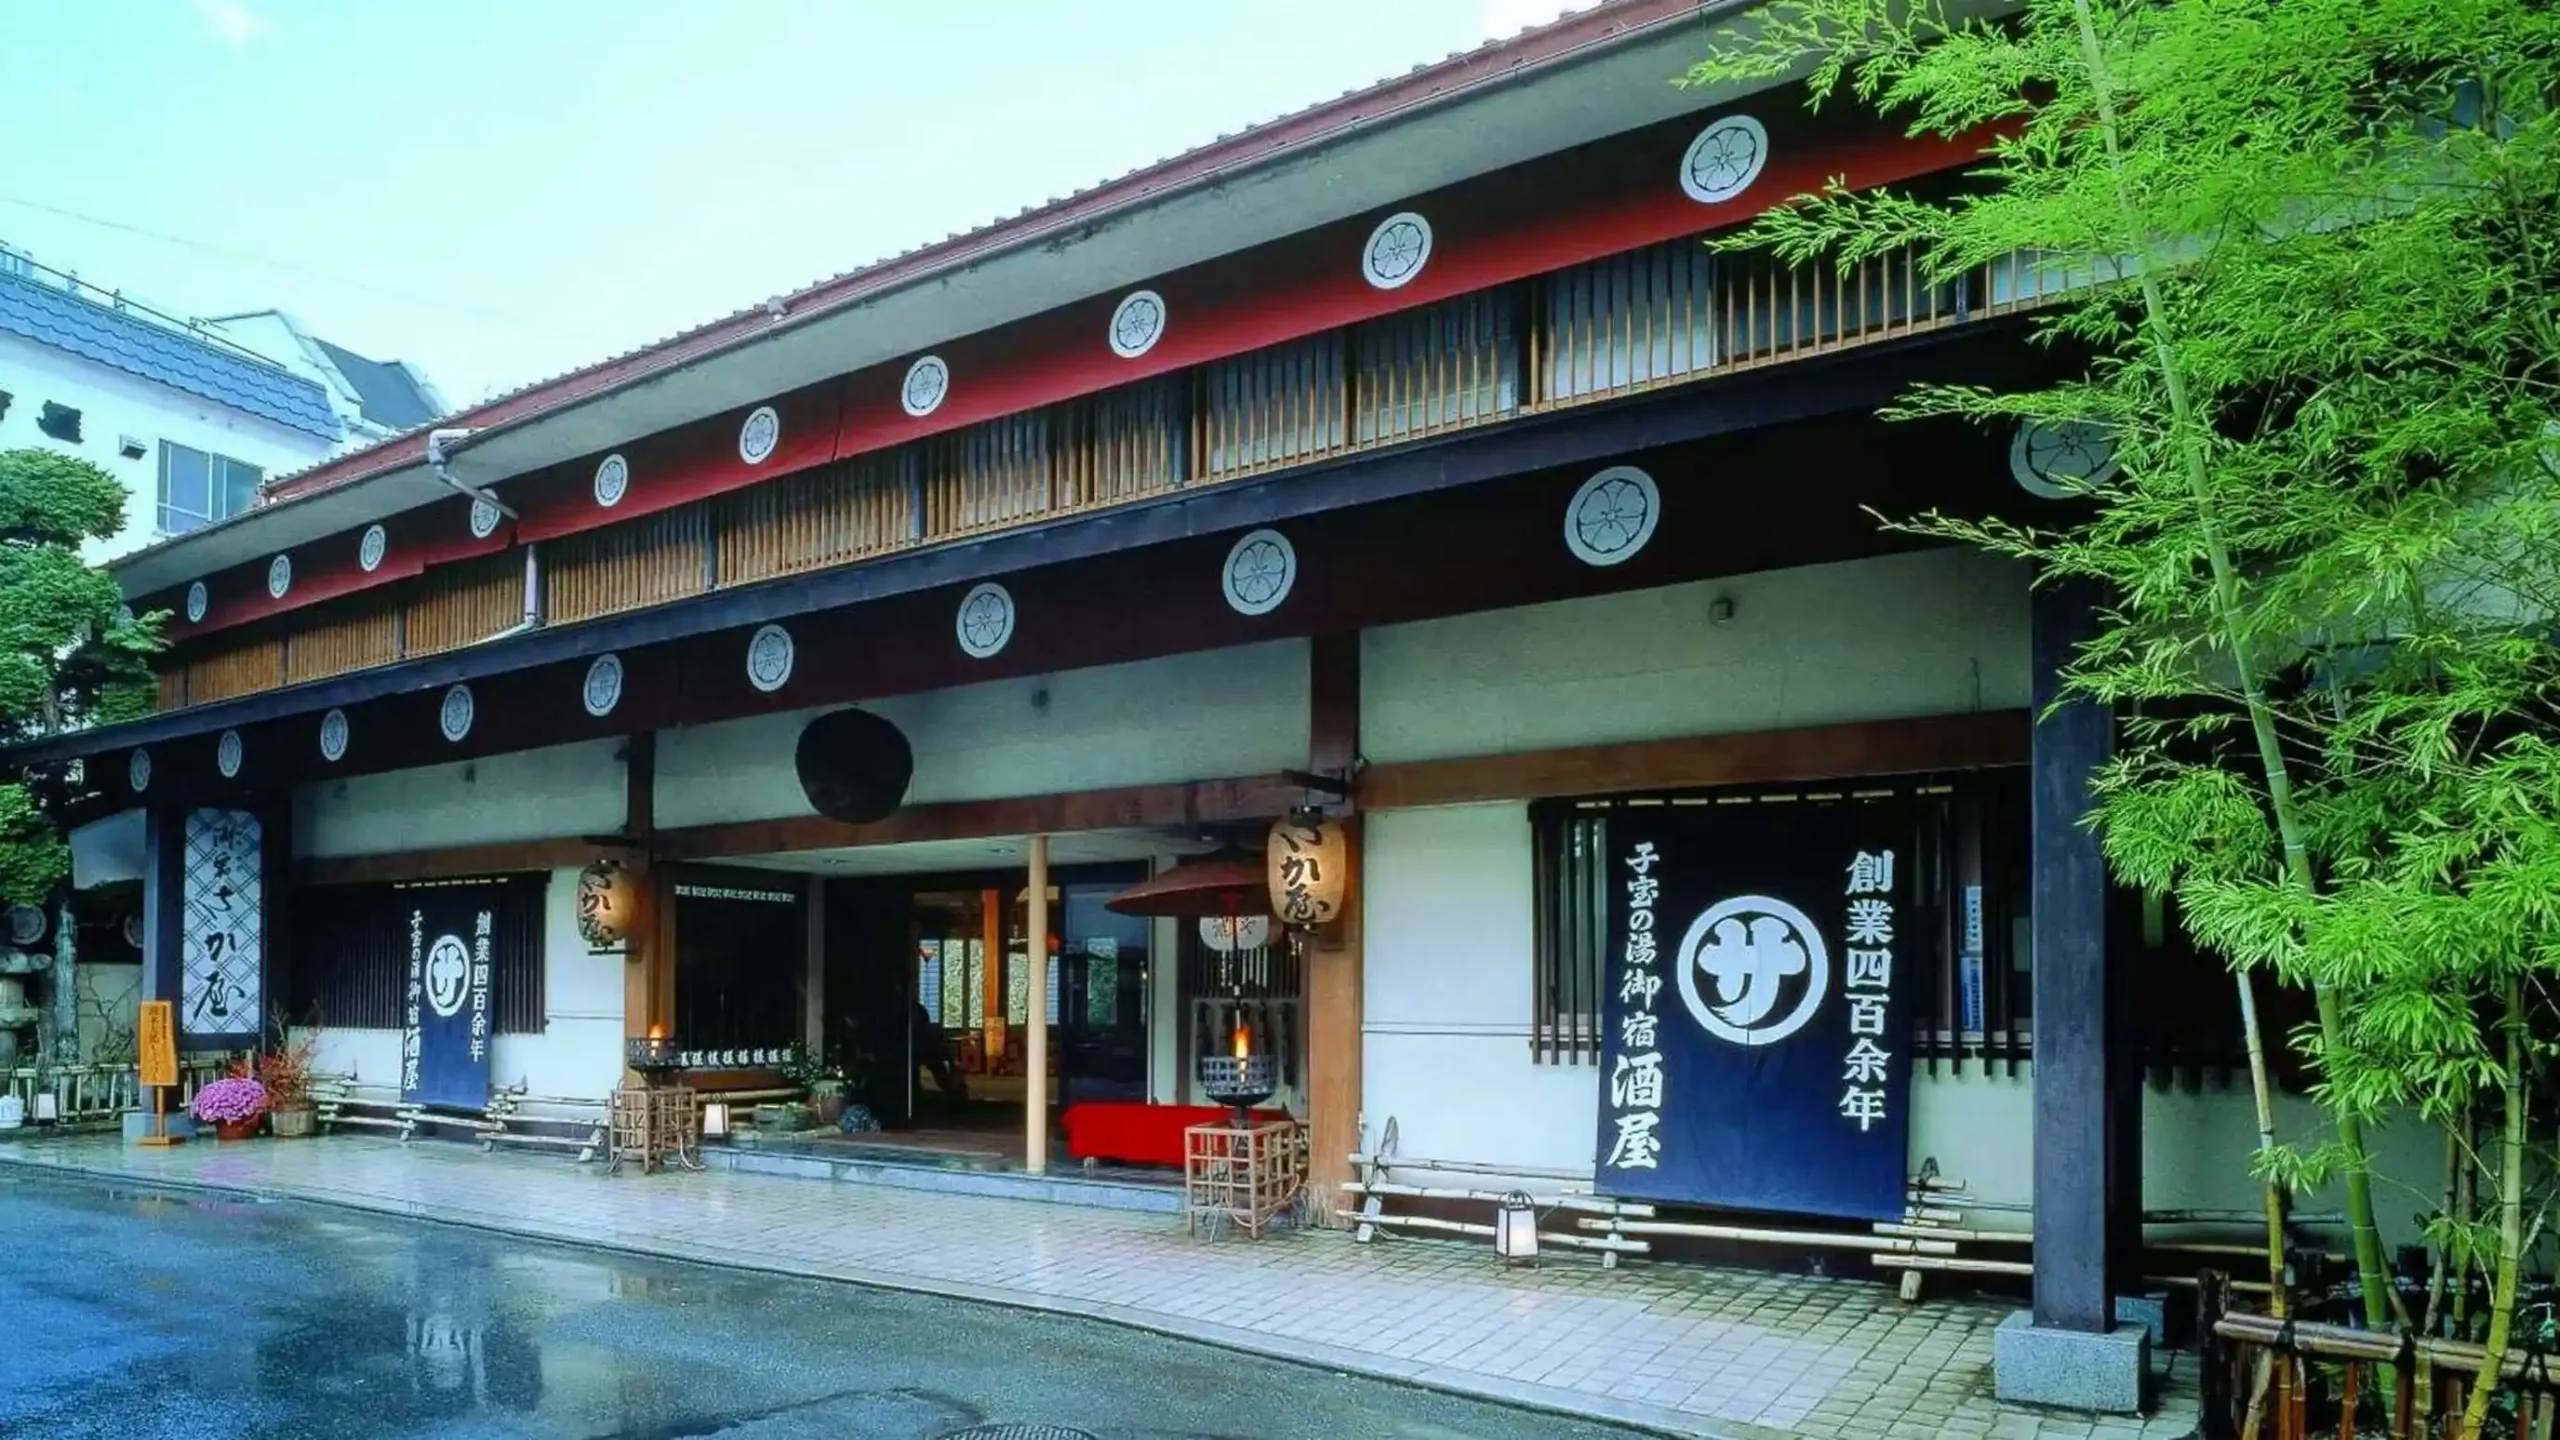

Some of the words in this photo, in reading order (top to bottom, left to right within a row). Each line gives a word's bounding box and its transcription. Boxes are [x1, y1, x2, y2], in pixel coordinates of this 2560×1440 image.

[470, 911, 493, 1063] 創業四百余年
[1605, 841, 1664, 1170] 子宝の湯御宿酒屋
[1838, 849, 1896, 1133] 創業四百余年
